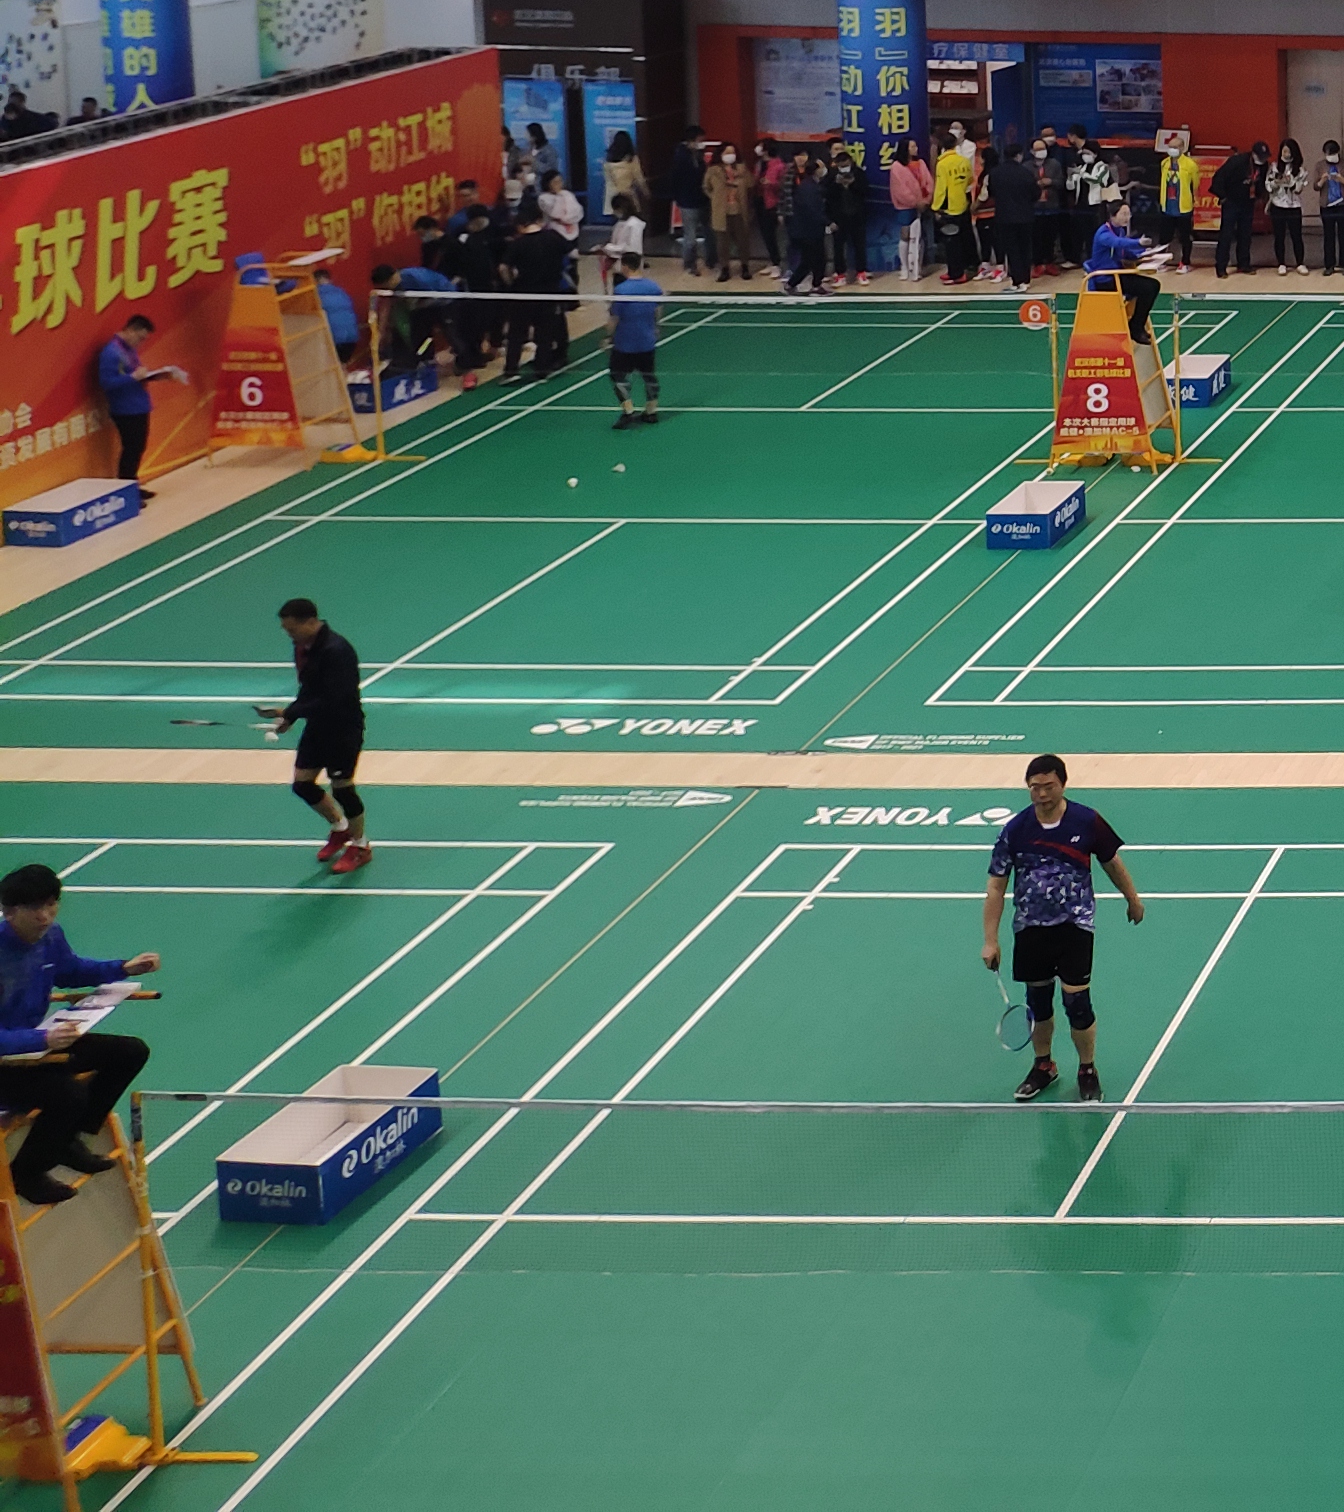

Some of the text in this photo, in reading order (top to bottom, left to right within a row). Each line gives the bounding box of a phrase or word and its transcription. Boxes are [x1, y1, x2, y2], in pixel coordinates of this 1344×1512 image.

[10, 166, 230, 335] 球比赛
[1028, 305, 1042, 321] 6
[240, 376, 264, 407] 6
[1086, 382, 1109, 413] 8
[1002, 522, 1041, 534] Okalin
[616, 718, 758, 736] YONEX
[803, 805, 952, 826] YONEX
[361, 1106, 419, 1165] Okalin
[245, 1179, 306, 1199] Okalin
